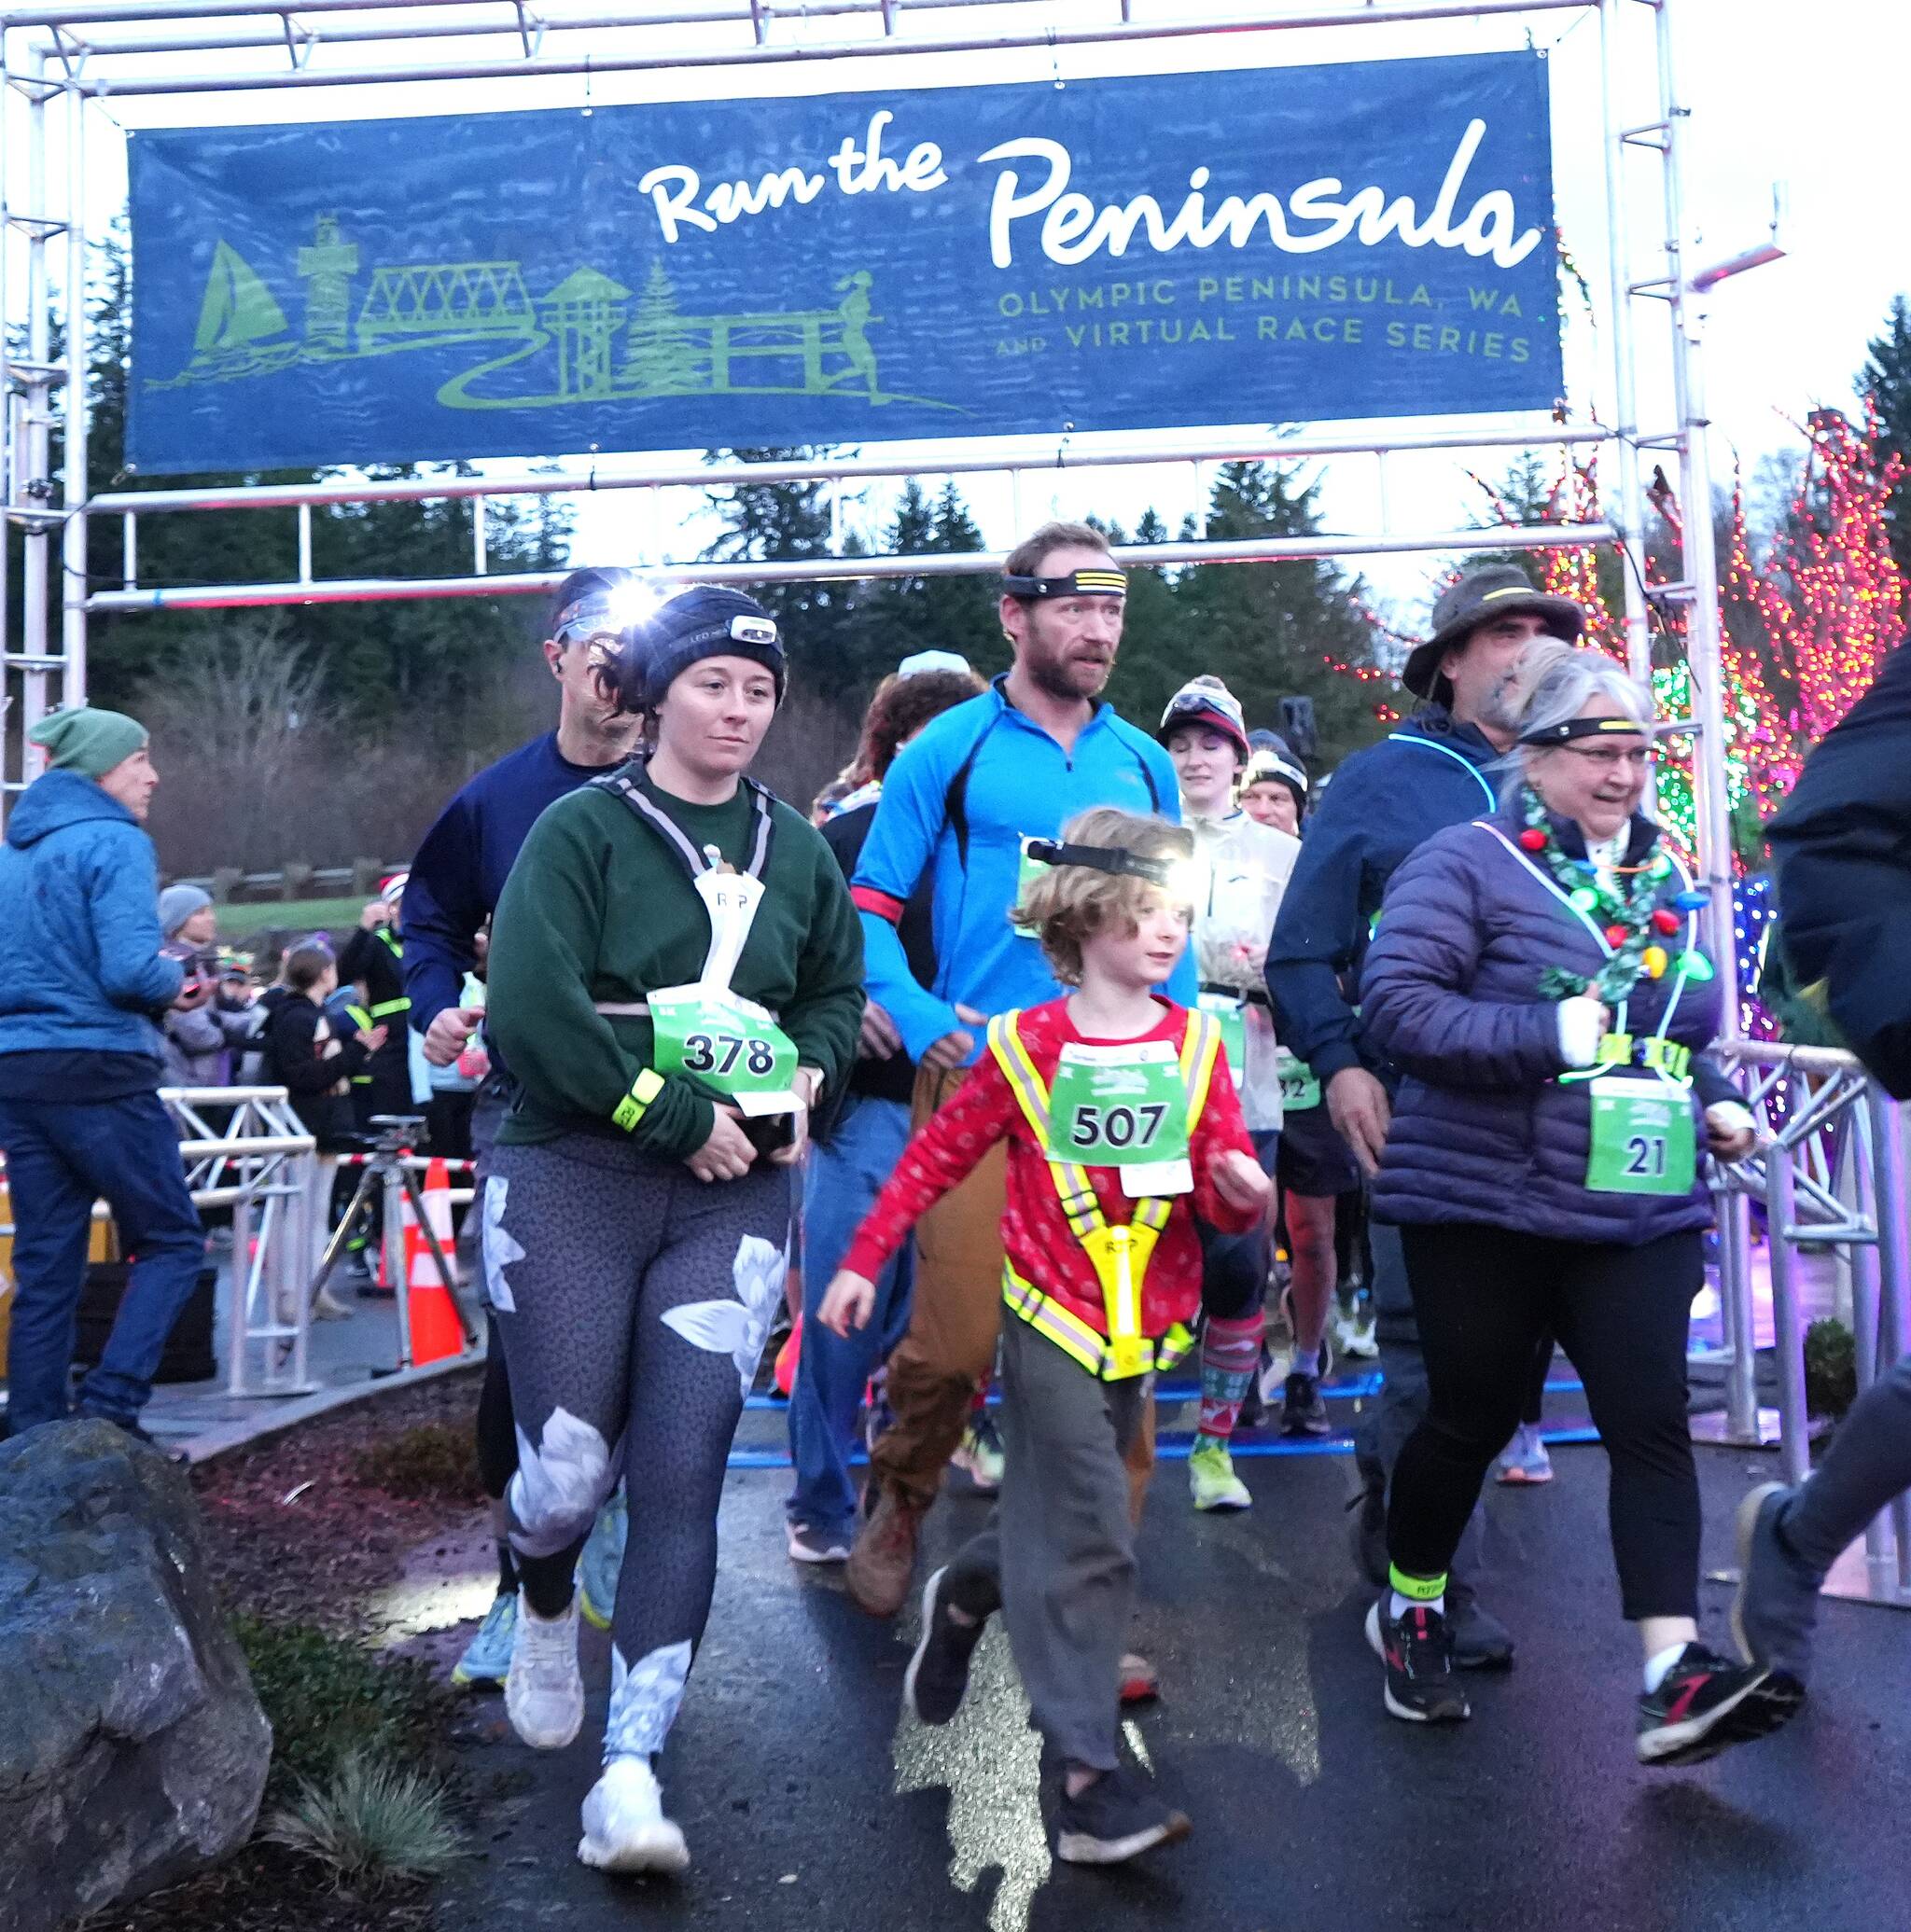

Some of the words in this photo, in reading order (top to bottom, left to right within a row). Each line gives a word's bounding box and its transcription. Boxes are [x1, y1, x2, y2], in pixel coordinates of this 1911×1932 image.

[638, 164, 825, 243] Run
[828, 110, 949, 194] the
[977, 118, 1542, 269] Peninsula
[998, 283, 1176, 317] OLYMPIC
[1198, 276, 1444, 312] PENINSULA,
[1468, 286, 1522, 318] WA
[997, 337, 1047, 357] AND
[1066, 317, 1236, 348] VIRTUAL
[1258, 315, 1363, 343] RACE
[1387, 322, 1530, 363] SERIES
[682, 1034, 774, 1076] 378
[1073, 1104, 1168, 1148] 507
[1627, 1136, 1667, 1175] 21
